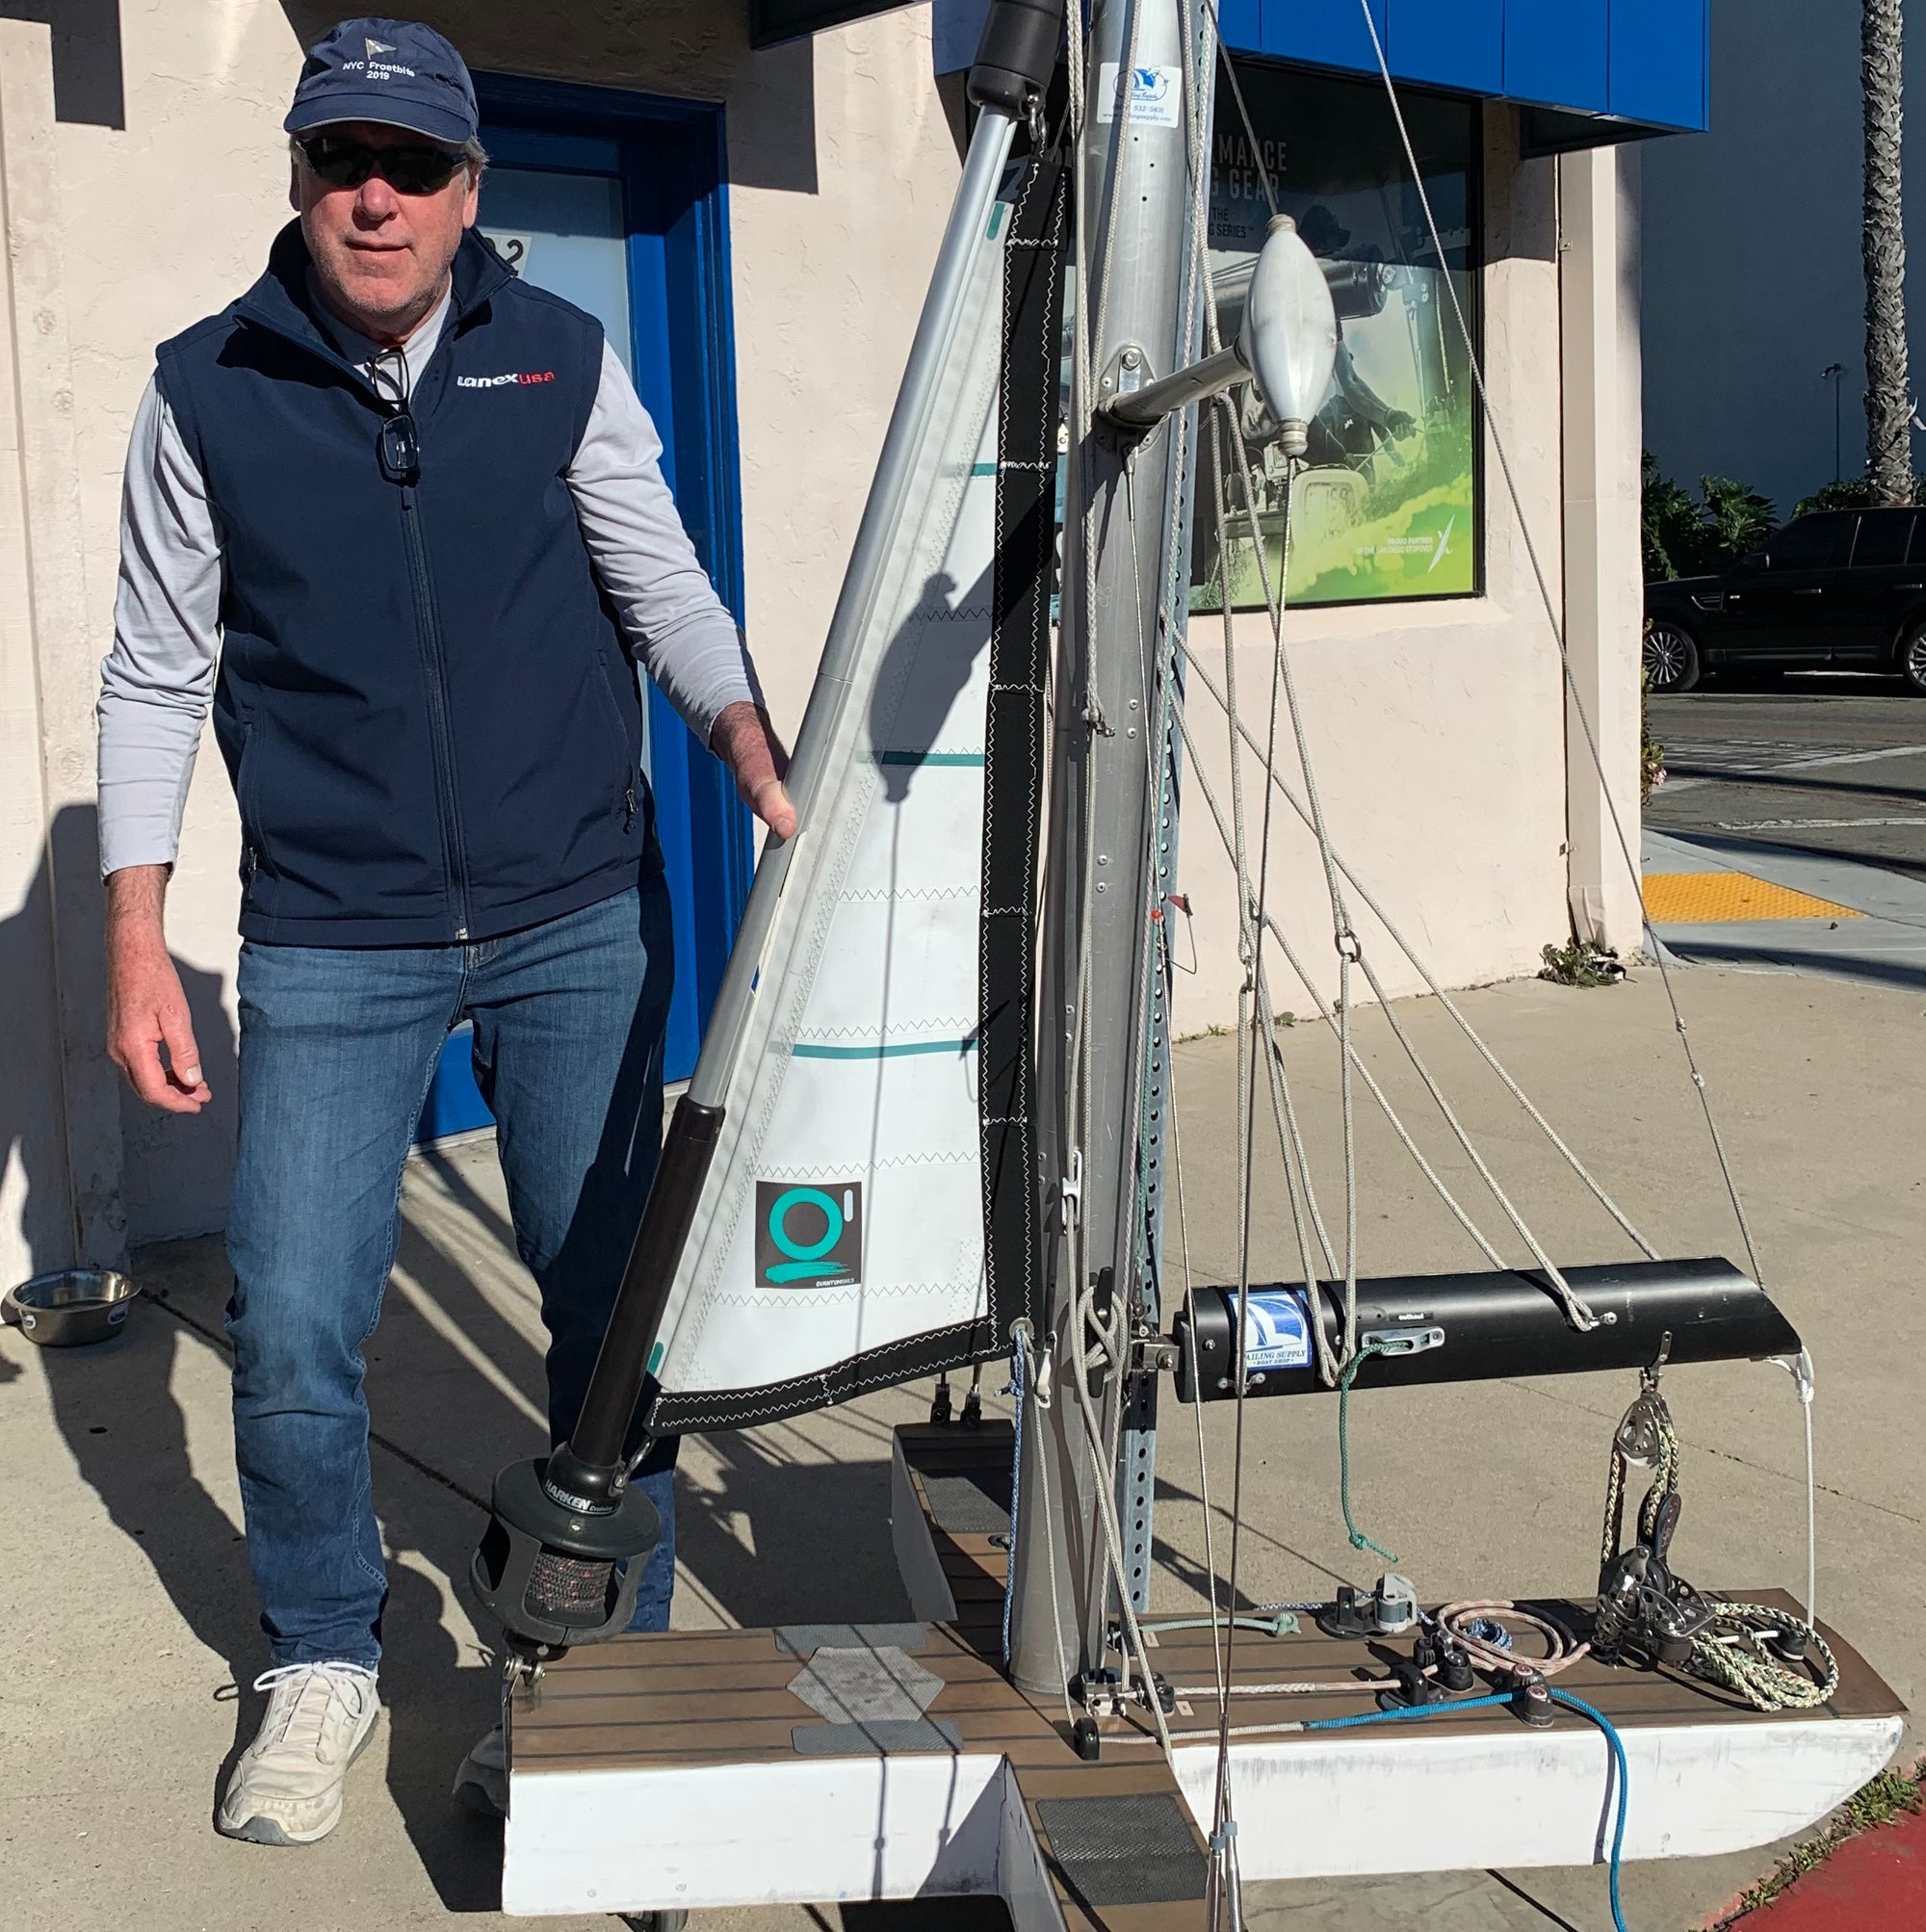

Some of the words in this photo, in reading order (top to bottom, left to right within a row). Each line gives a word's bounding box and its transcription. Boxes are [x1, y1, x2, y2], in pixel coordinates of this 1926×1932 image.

[343, 62, 365, 70] NYC
[369, 62, 416, 78] Frostbite
[366, 70, 390, 81] 2019
[1212, 133, 1288, 172] MANCE
[1229, 168, 1281, 205] GEAR
[1213, 207, 1229, 221] THE
[1387, 536, 1407, 546] PROUD
[1408, 536, 1434, 545] PARTNER
[1388, 545, 1405, 554] DIEGO
[1397, 1312, 1424, 1321] outhaul
[1245, 1350, 1275, 1362] AILING
[1276, 1348, 1307, 1359] SUPPLY
[544, 1478, 592, 1511] HARKEN
